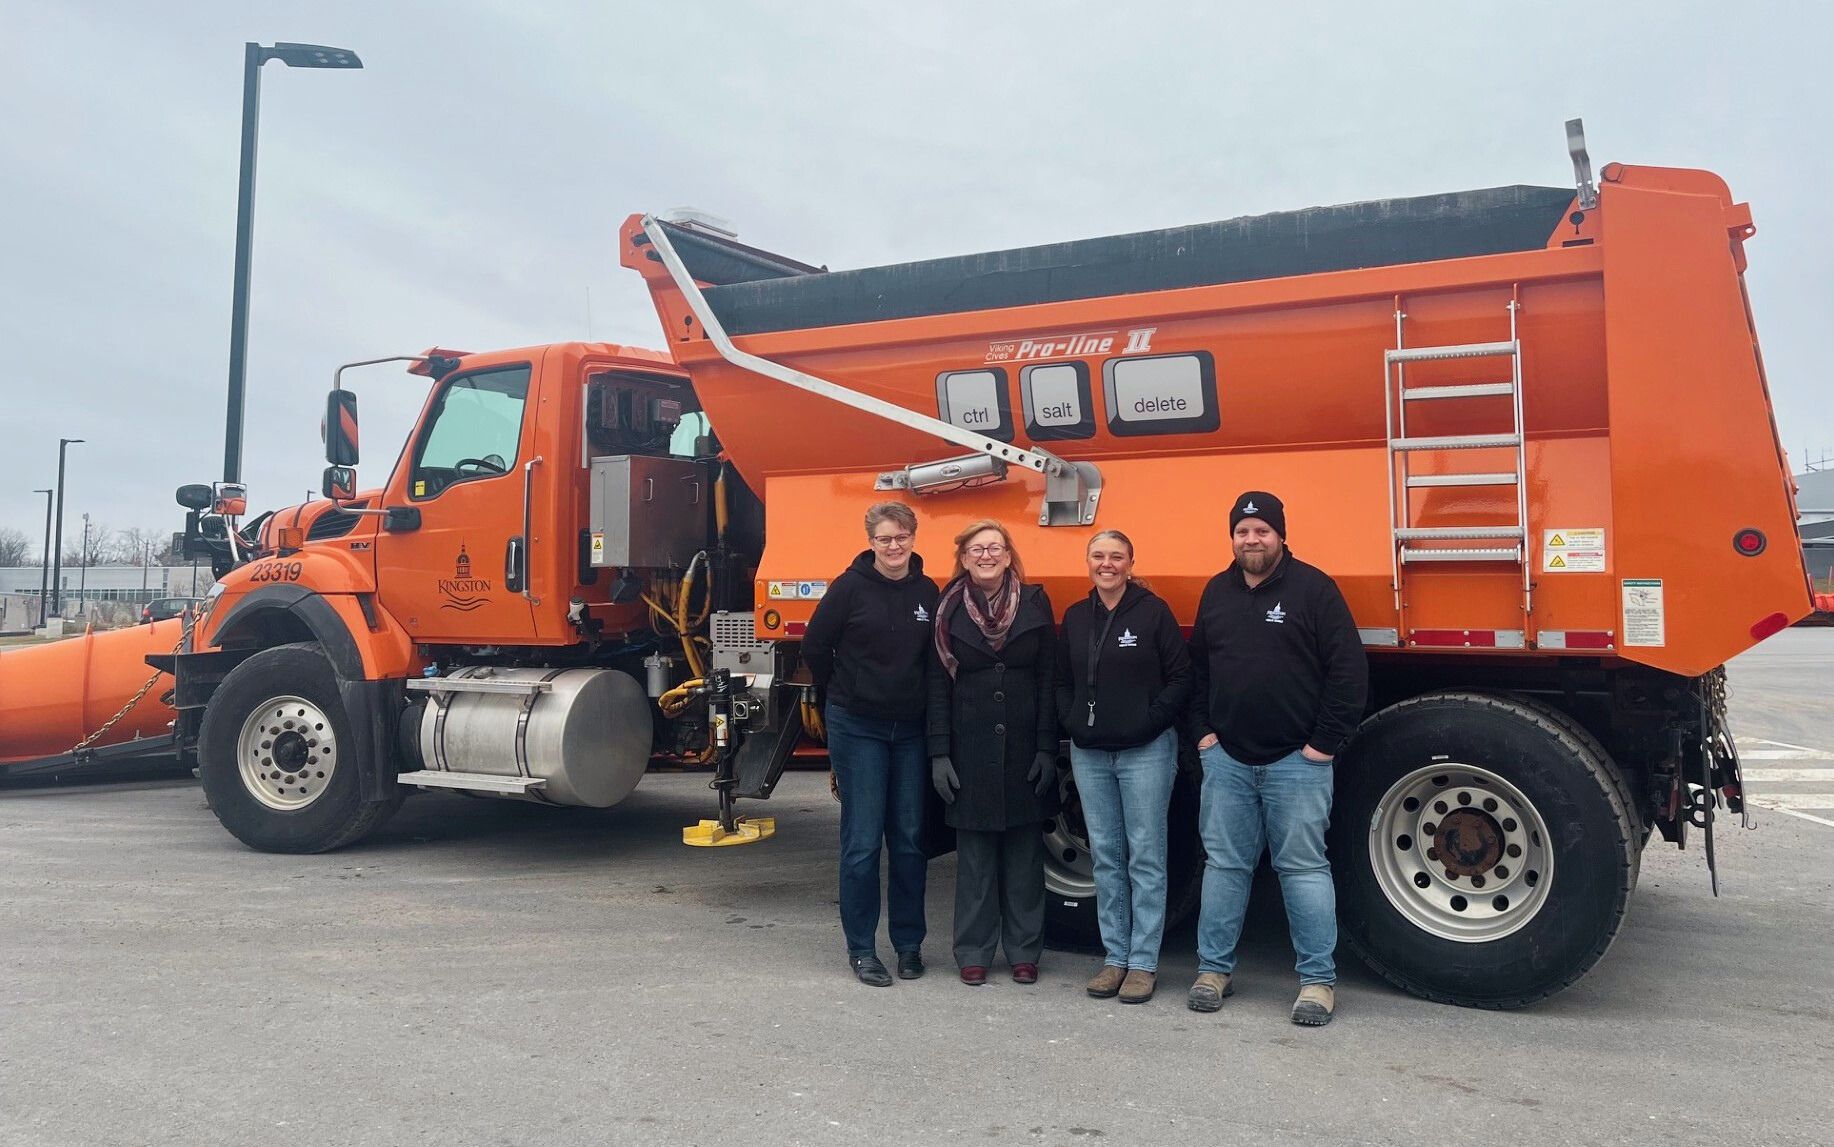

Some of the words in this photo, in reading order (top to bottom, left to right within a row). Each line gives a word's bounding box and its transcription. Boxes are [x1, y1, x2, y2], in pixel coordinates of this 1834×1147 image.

[985, 351, 1009, 361] Cives
[988, 342, 1014, 353] Viking
[1014, 335, 1114, 360] Pro-line
[1042, 402, 1073, 419] salt
[1134, 396, 1187, 413] delete
[962, 407, 988, 424] ctrl
[350, 542, 371, 550] HV
[249, 561, 303, 582] 23319
[438, 579, 491, 594] KINGSTON
